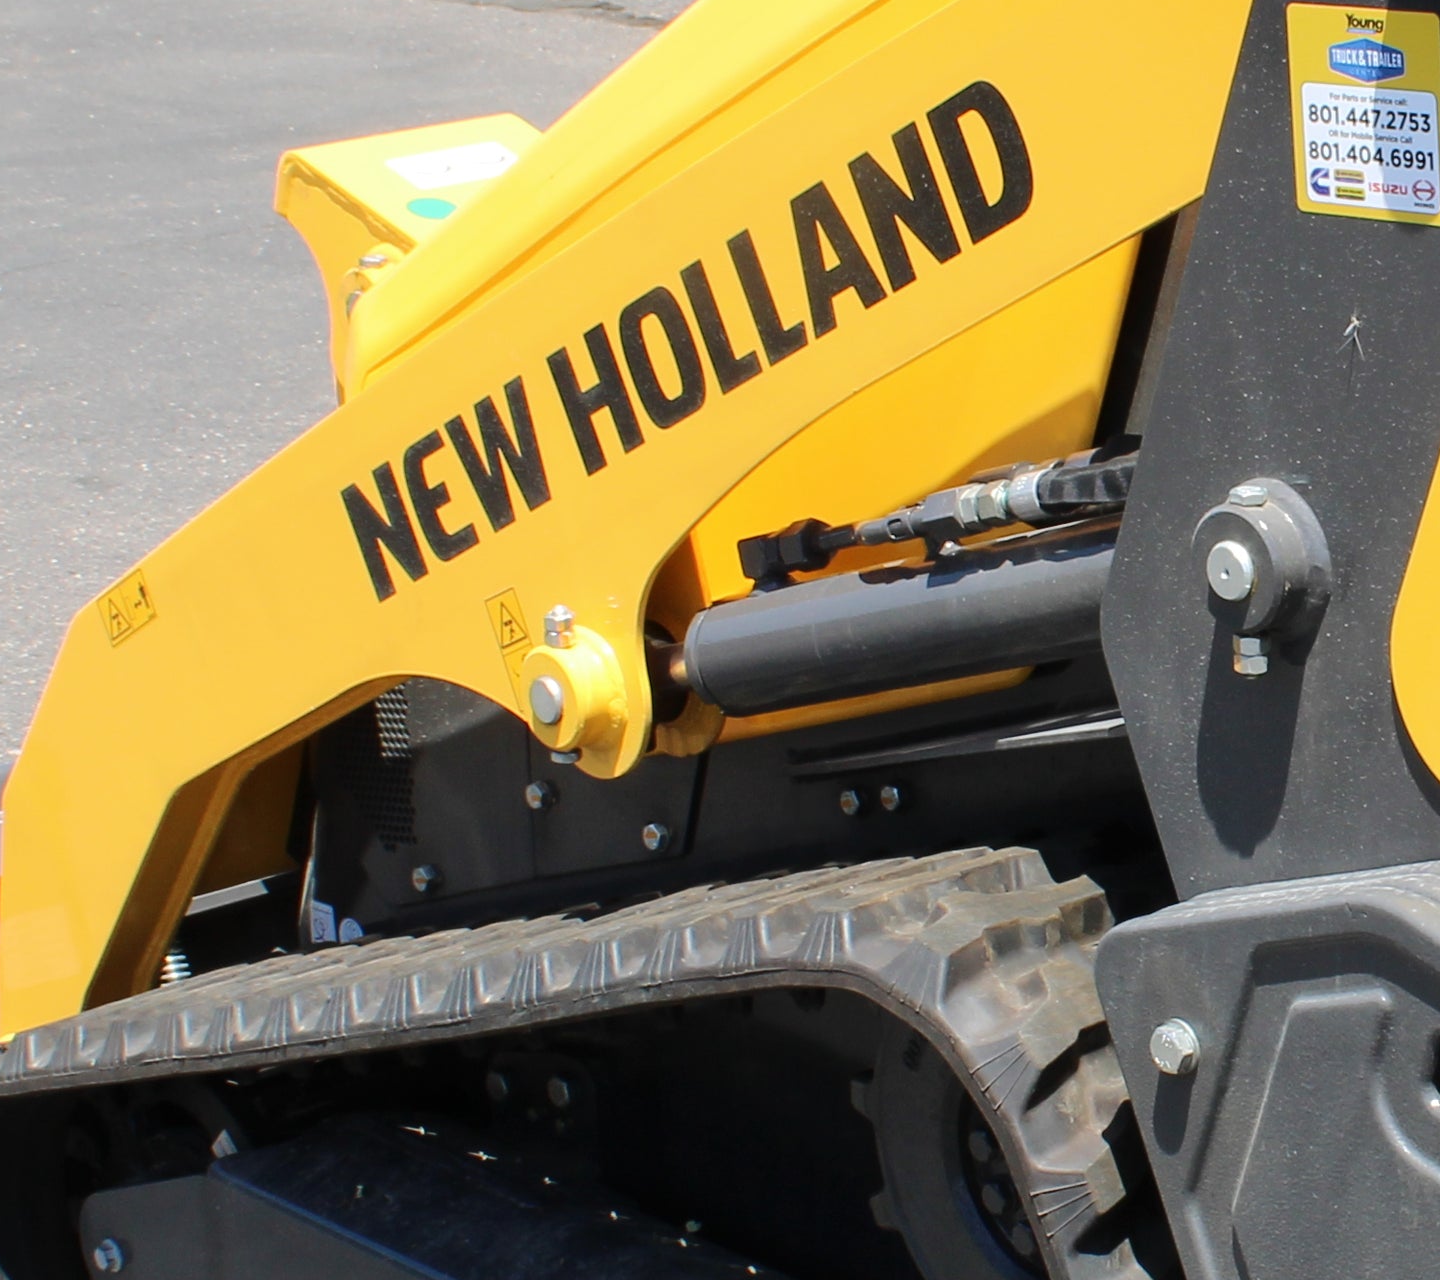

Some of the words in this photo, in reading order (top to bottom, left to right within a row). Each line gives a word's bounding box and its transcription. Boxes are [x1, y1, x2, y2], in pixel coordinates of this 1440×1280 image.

[1345, 13, 1384, 33] Young
[1329, 92, 1340, 100] For
[1342, 93, 1359, 102] Parts
[1369, 96, 1393, 105] Service
[1308, 104, 1432, 132] 801.447.2753
[1351, 132, 1373, 141] Mobile
[1374, 134, 1399, 143] Service
[1400, 136, 1413, 144] Call
[1309, 141, 1434, 171] 801.404.6991
[1368, 182, 1408, 195] ISUZU
[341, 376, 551, 601] NEW
[546, 80, 1034, 475] HOLLAND
